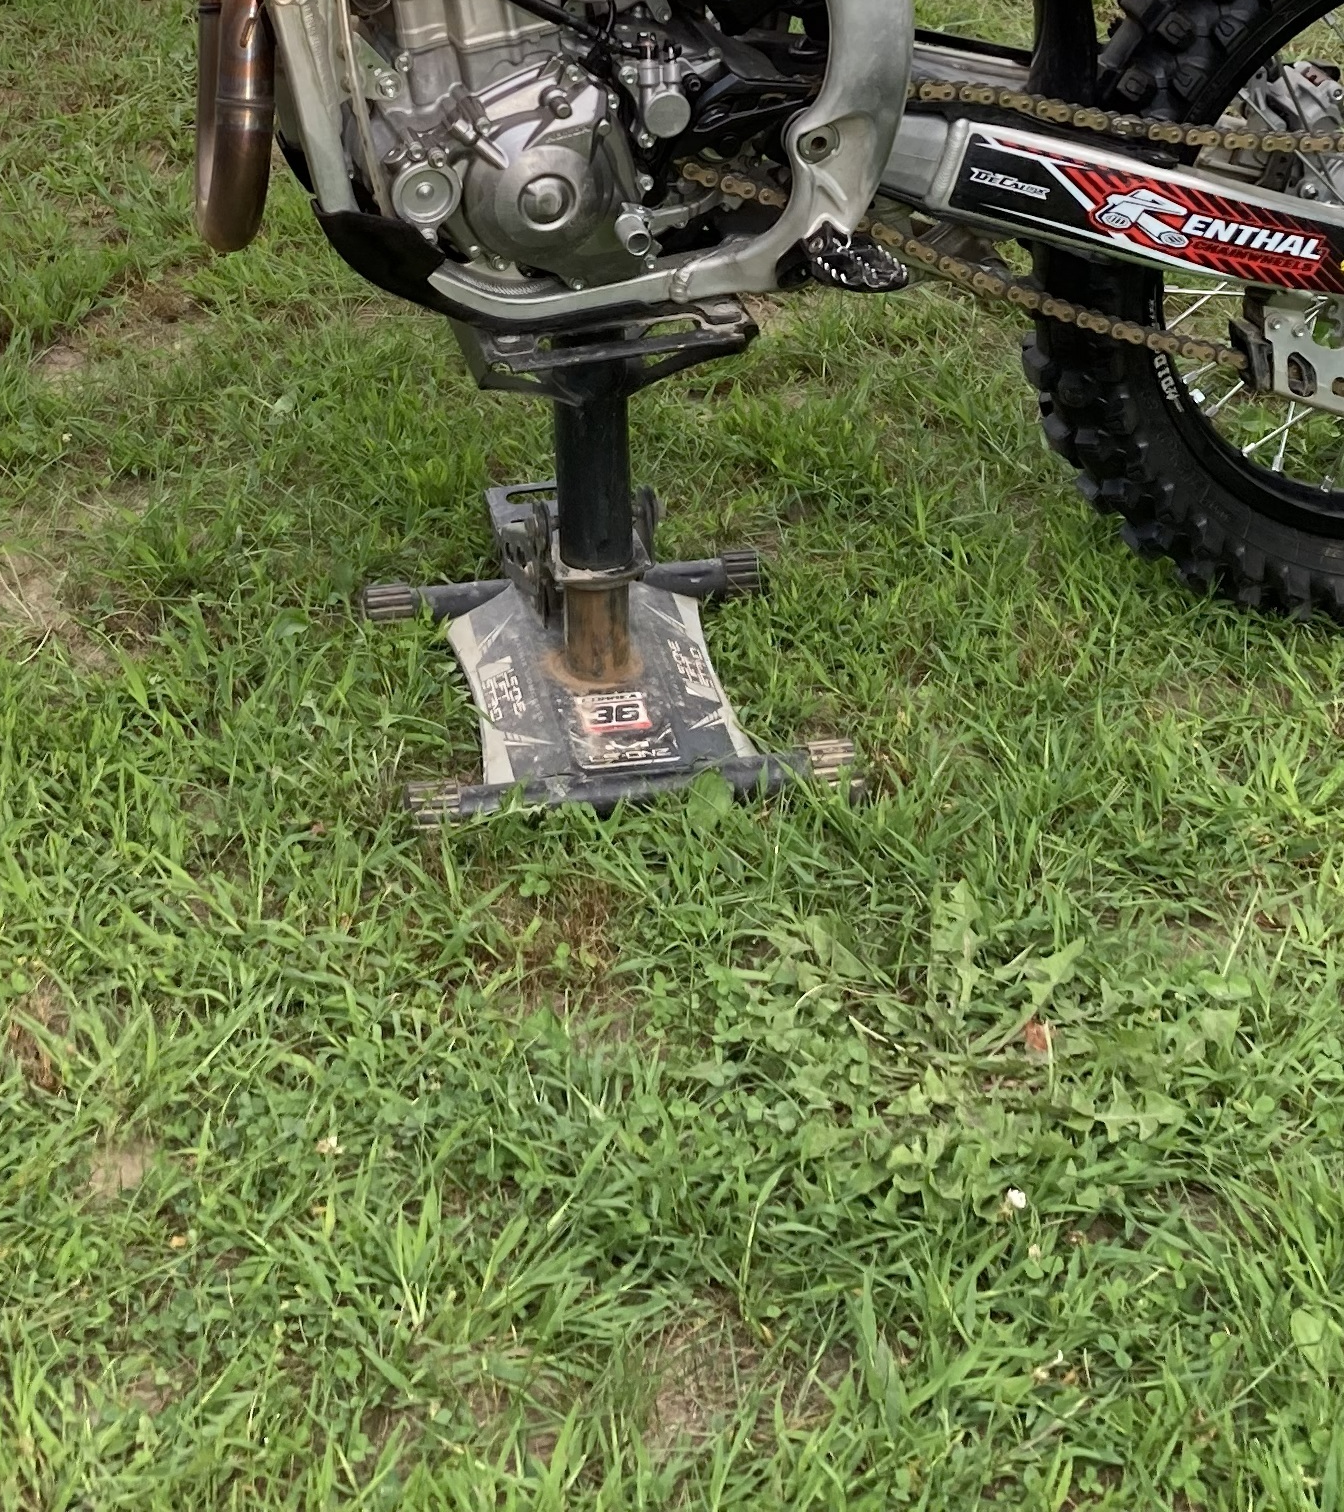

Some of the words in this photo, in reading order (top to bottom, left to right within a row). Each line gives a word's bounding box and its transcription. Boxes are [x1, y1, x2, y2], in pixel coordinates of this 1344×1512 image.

[1093, 188, 1324, 261] RENTHAL
[1192, 238, 1316, 273] CHAINWHEELS
[590, 703, 640, 724] 36
